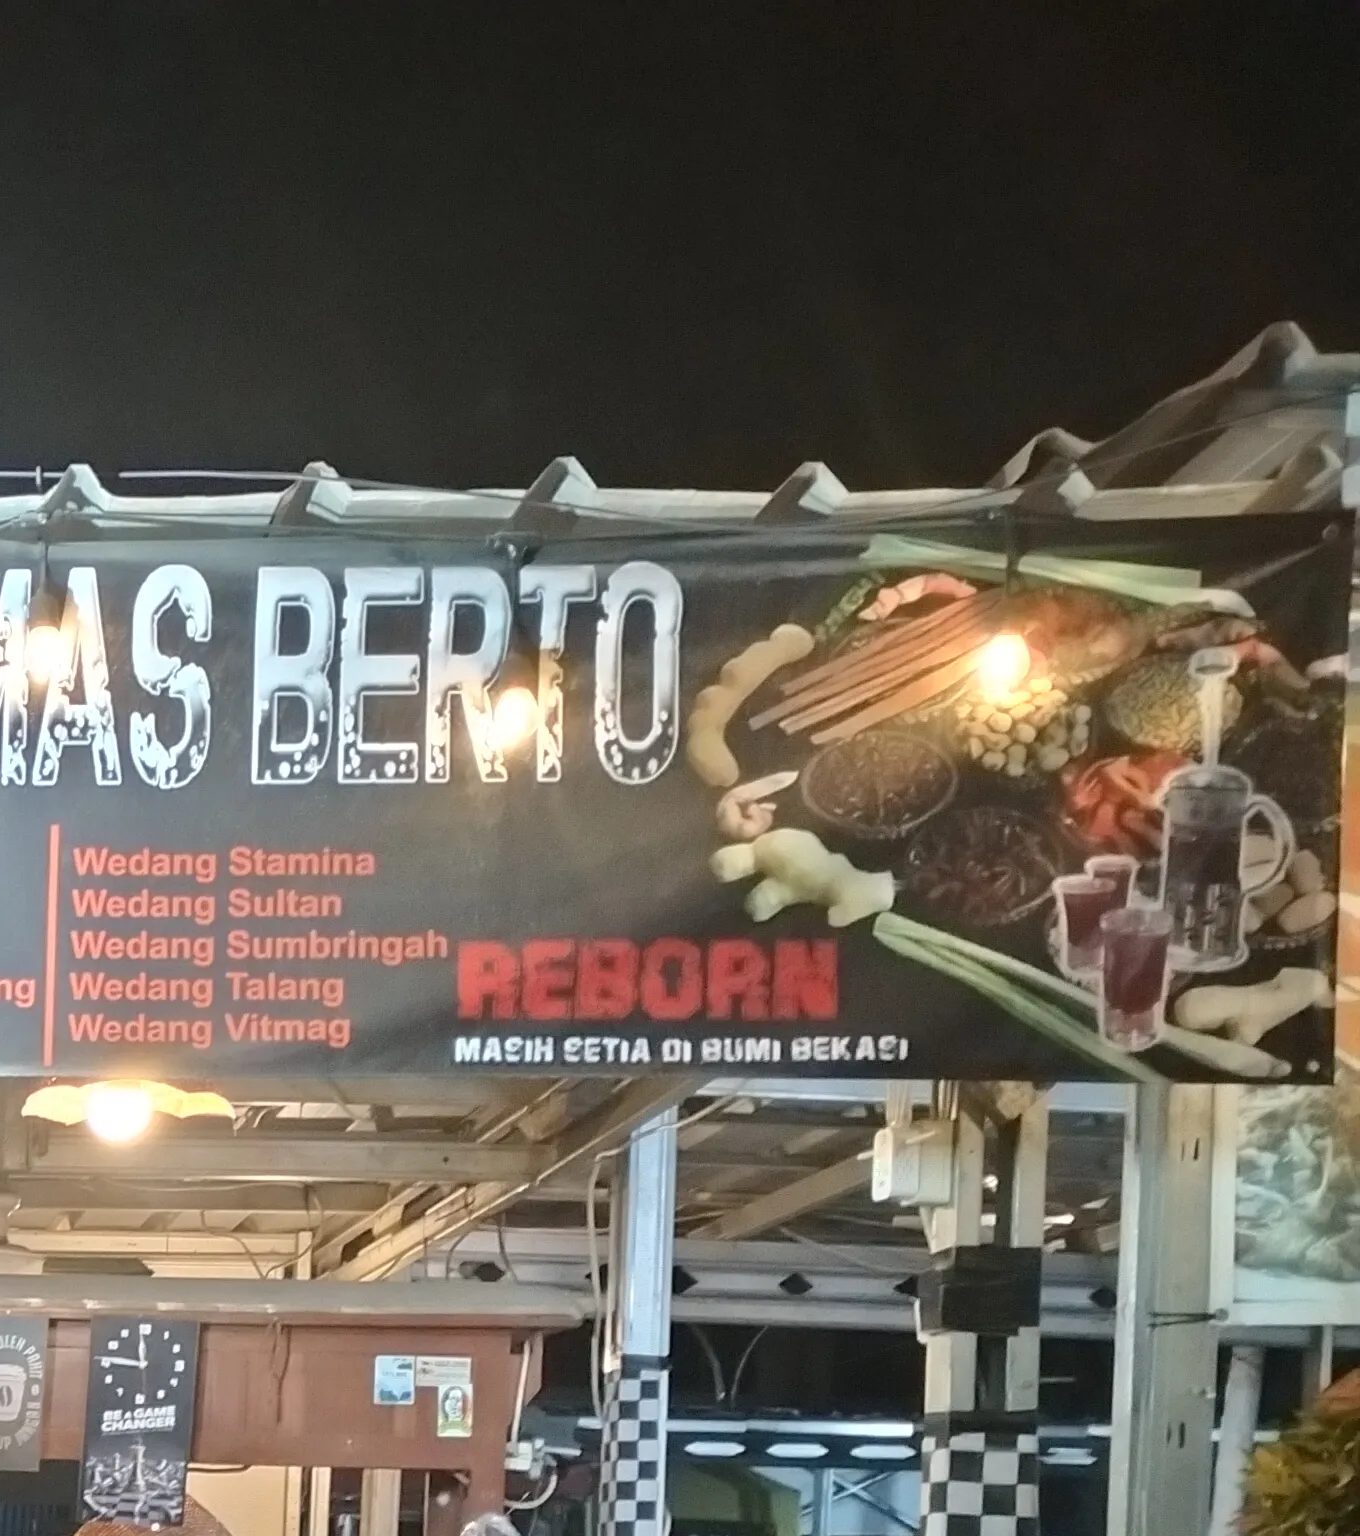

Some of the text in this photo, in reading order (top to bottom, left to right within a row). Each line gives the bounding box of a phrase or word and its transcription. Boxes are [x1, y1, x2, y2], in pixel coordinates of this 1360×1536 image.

[251, 561, 684, 786] BERTO
[73, 845, 376, 883] Wedang Stamina
[72, 887, 343, 925] Wedang Sultan
[70, 928, 448, 966] Wedang Sumbringah
[69, 971, 345, 1008] Wedang Talang
[457, 935, 839, 1022] REBORN
[68, 1011, 351, 1049] Wedang Vitmag
[454, 1034, 909, 1064] MASIH SETIA DI BUMI BEKASI
[101, 1416, 176, 1432] CHANGER
